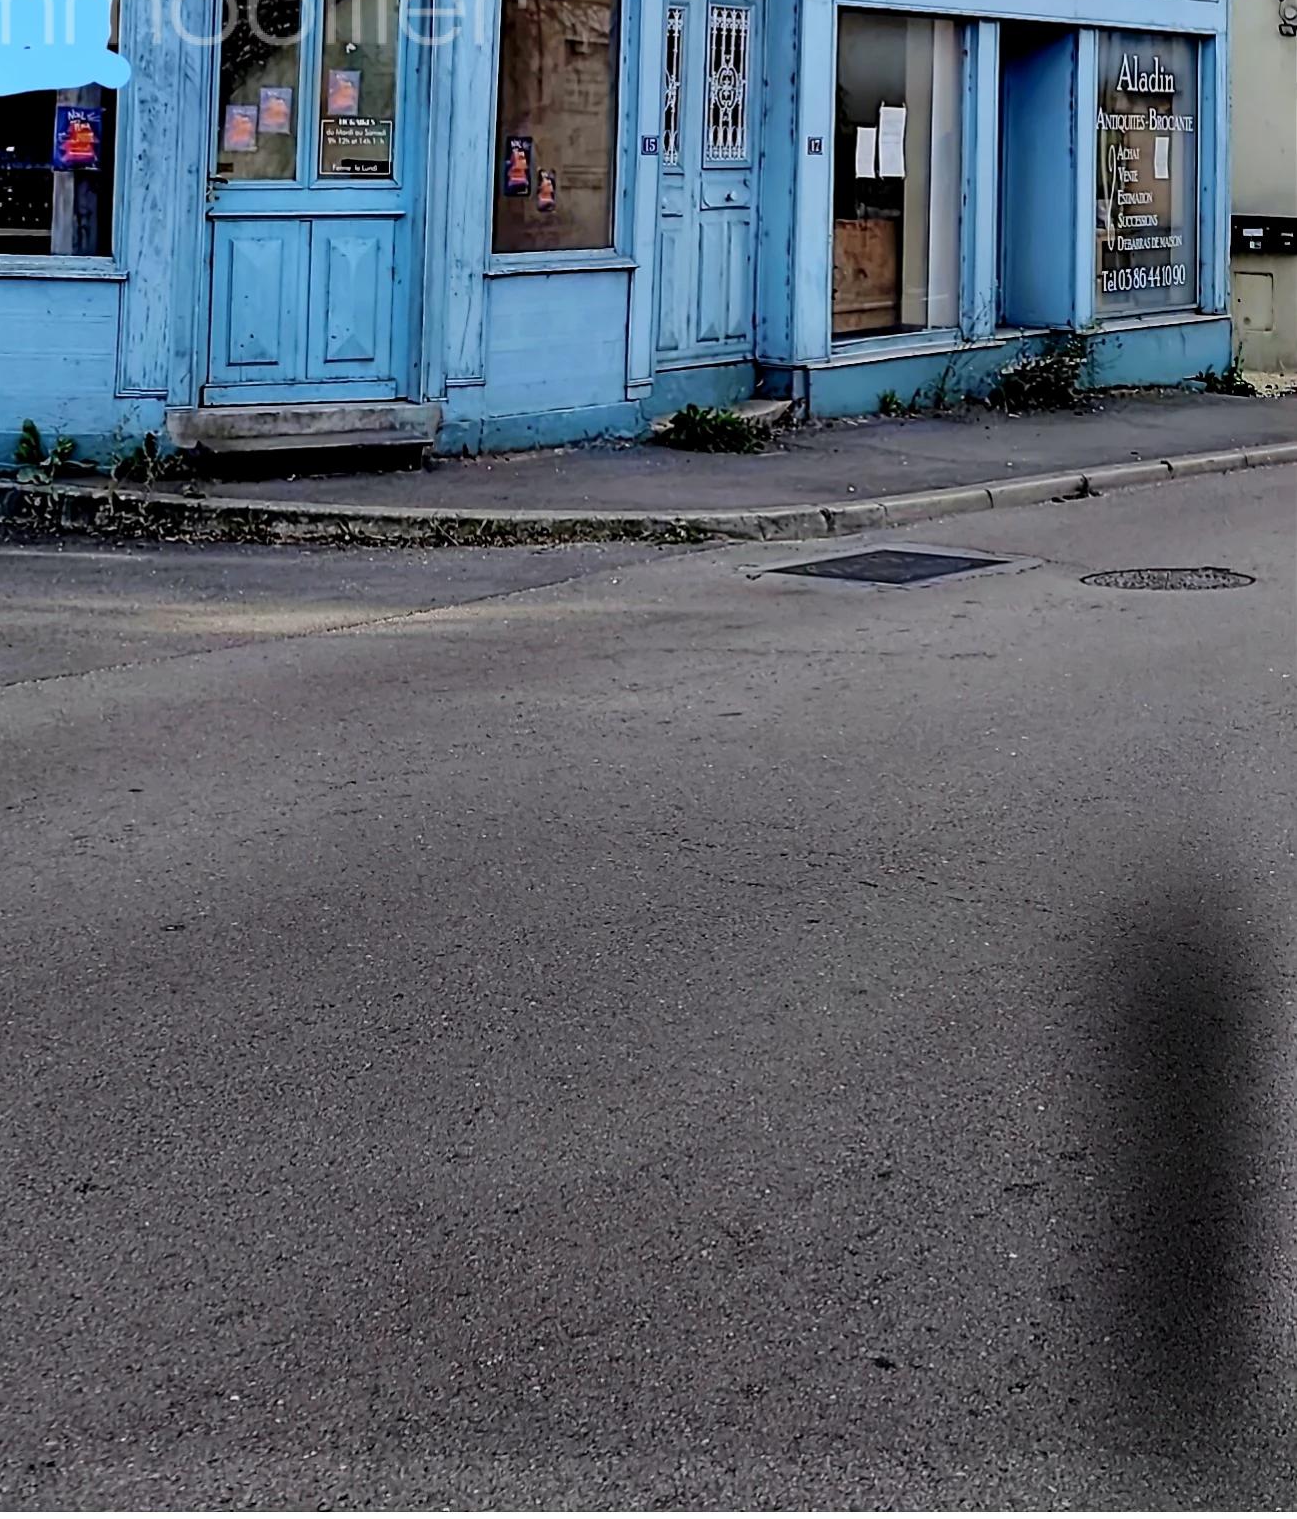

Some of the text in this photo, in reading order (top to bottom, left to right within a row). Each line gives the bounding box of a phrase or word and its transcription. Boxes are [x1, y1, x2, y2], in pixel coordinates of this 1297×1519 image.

[1116, 53, 1175, 93] Aladin
[335, 128, 354, 136] Mardi
[645, 138, 656, 152] 15
[811, 139, 820, 152] 17
[1118, 268, 1132, 291] 03
[1133, 267, 1147, 289] 86
[1147, 265, 1161, 288] 44
[1161, 265, 1172, 287] 10
[1172, 264, 1186, 285] 90
